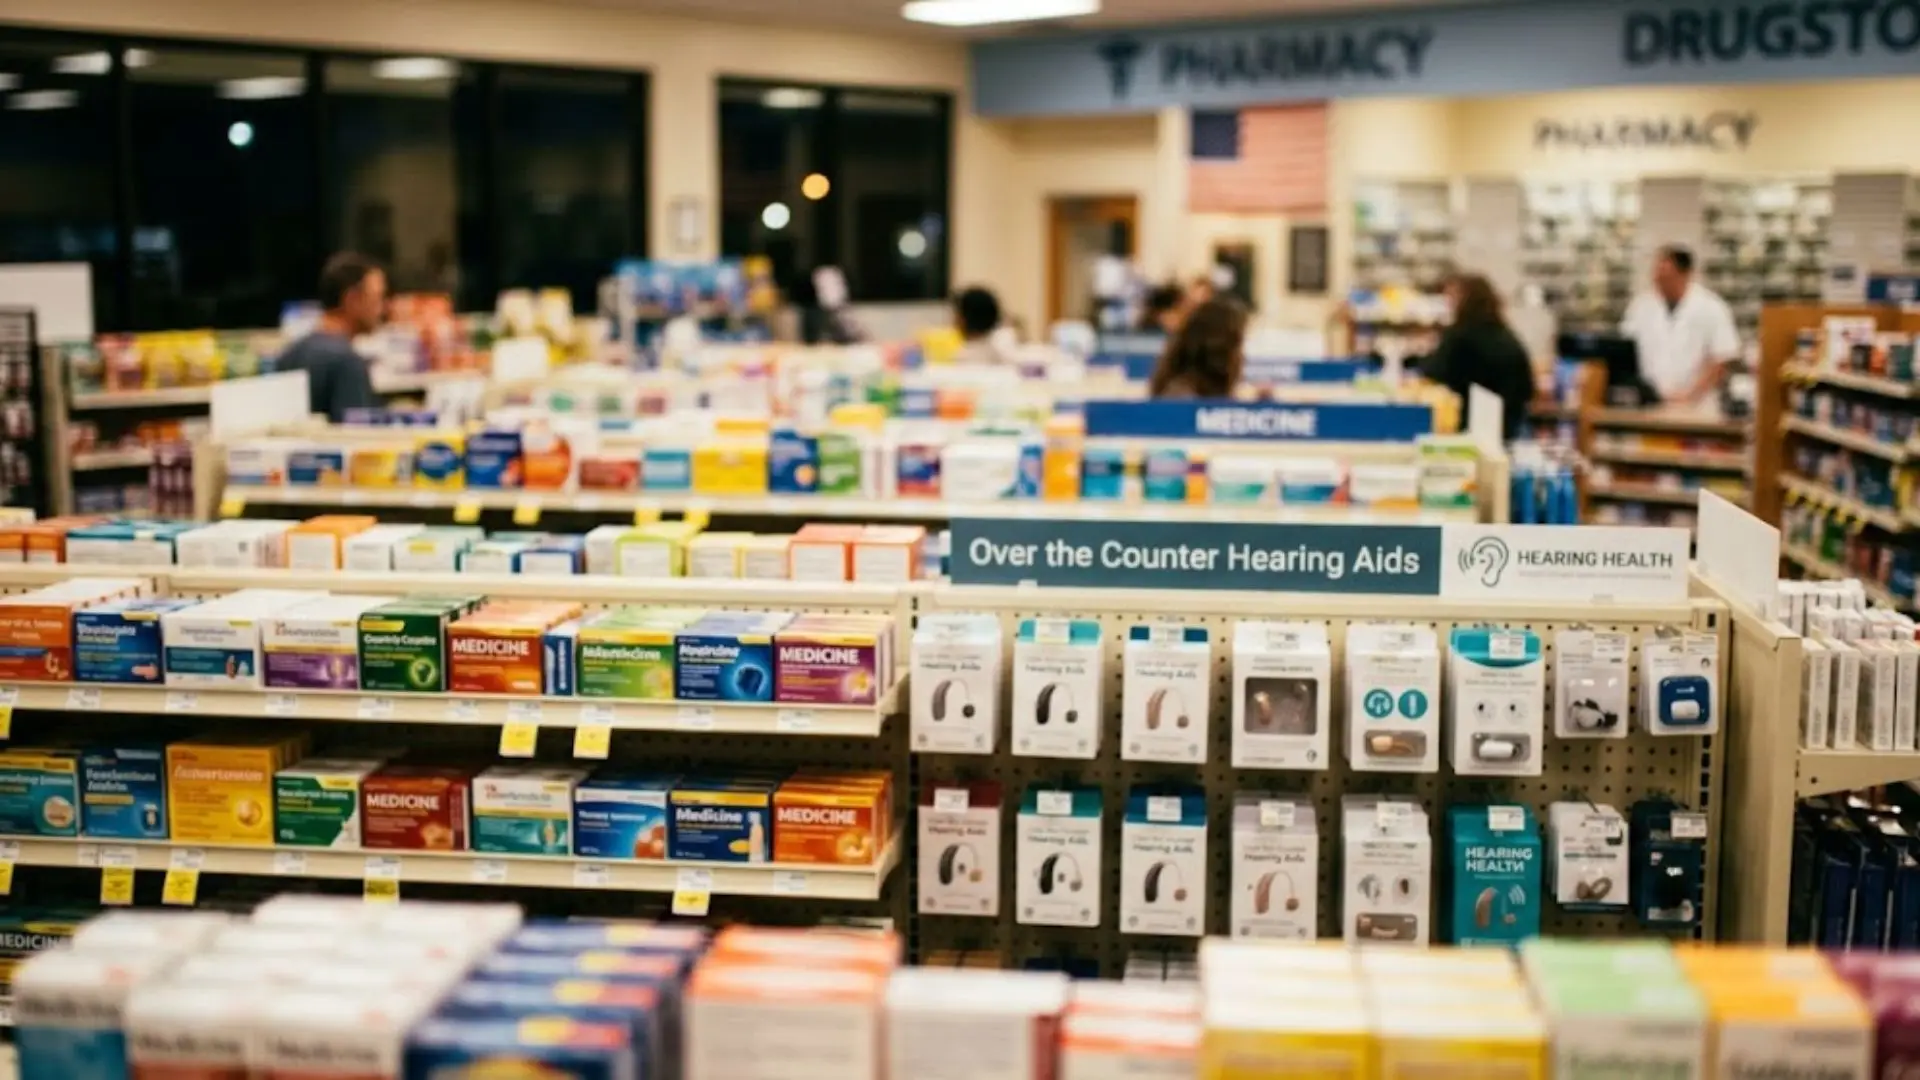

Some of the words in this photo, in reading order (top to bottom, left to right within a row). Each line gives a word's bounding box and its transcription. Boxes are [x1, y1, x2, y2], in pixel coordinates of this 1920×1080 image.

[1622, 2, 1920, 67] DRUGSTO
[1160, 29, 1433, 88] PHARMACY
[1534, 112, 1759, 152] PHARMACY
[1196, 407, 1318, 436] MEDICINE
[969, 537, 1038, 566] Over
[1045, 539, 1094, 567] the
[1101, 540, 1219, 570] Counter
[1228, 544, 1345, 580] Hearing
[1353, 546, 1420, 574] Aids
[1517, 550, 1598, 567] HEARING
[1602, 552, 1673, 568] HEALTH
[452, 638, 530, 656] MEDICINE
[779, 647, 859, 665] MEDICINE
[778, 808, 857, 826] MEDICINE
[1465, 847, 1532, 861] HEARING
[0, 933, 73, 951] EDICIN
